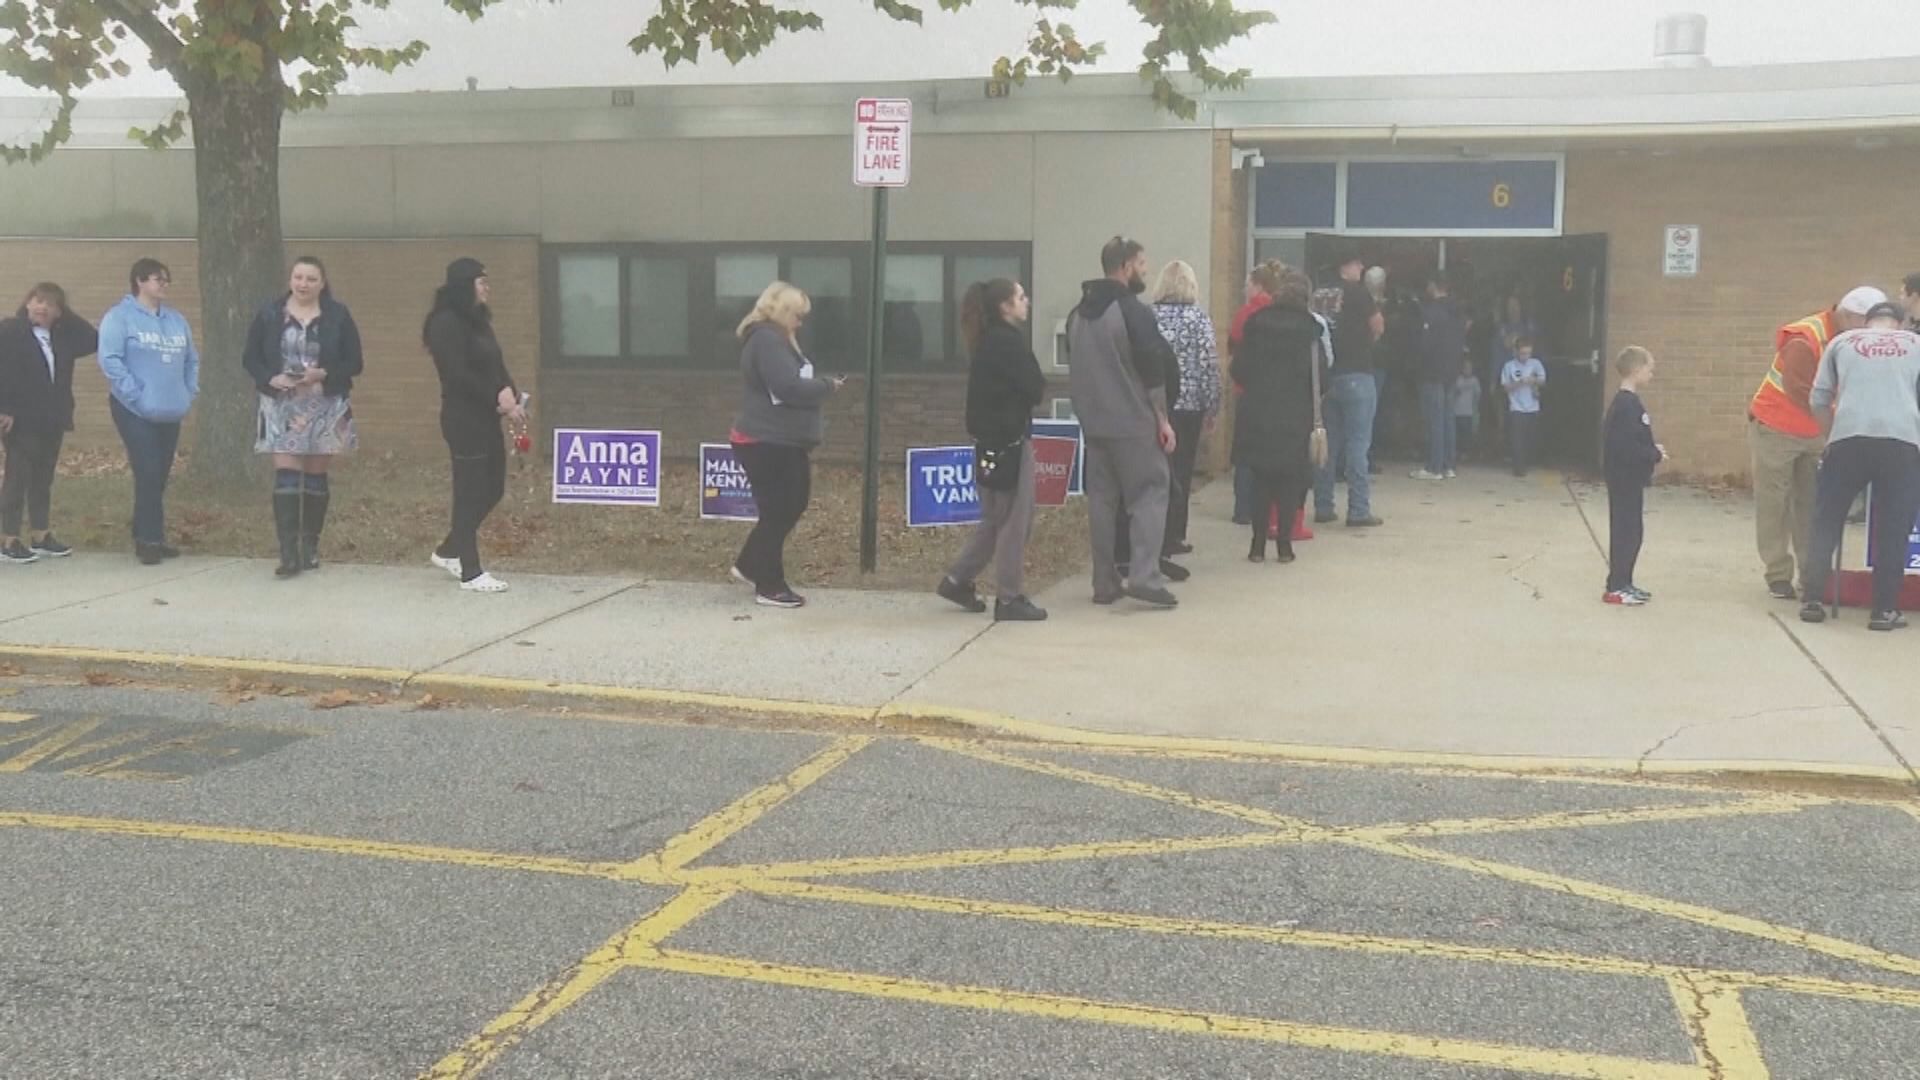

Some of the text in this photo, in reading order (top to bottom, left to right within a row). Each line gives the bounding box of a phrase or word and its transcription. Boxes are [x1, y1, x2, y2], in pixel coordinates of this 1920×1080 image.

[866, 135, 900, 151] FIRE
[863, 154, 901, 170] LANE
[1493, 183, 1510, 208] 6
[1562, 266, 1575, 291] 6
[565, 435, 648, 465] Anna
[563, 466, 649, 486] PAYNE
[921, 464, 976, 487] TRU
